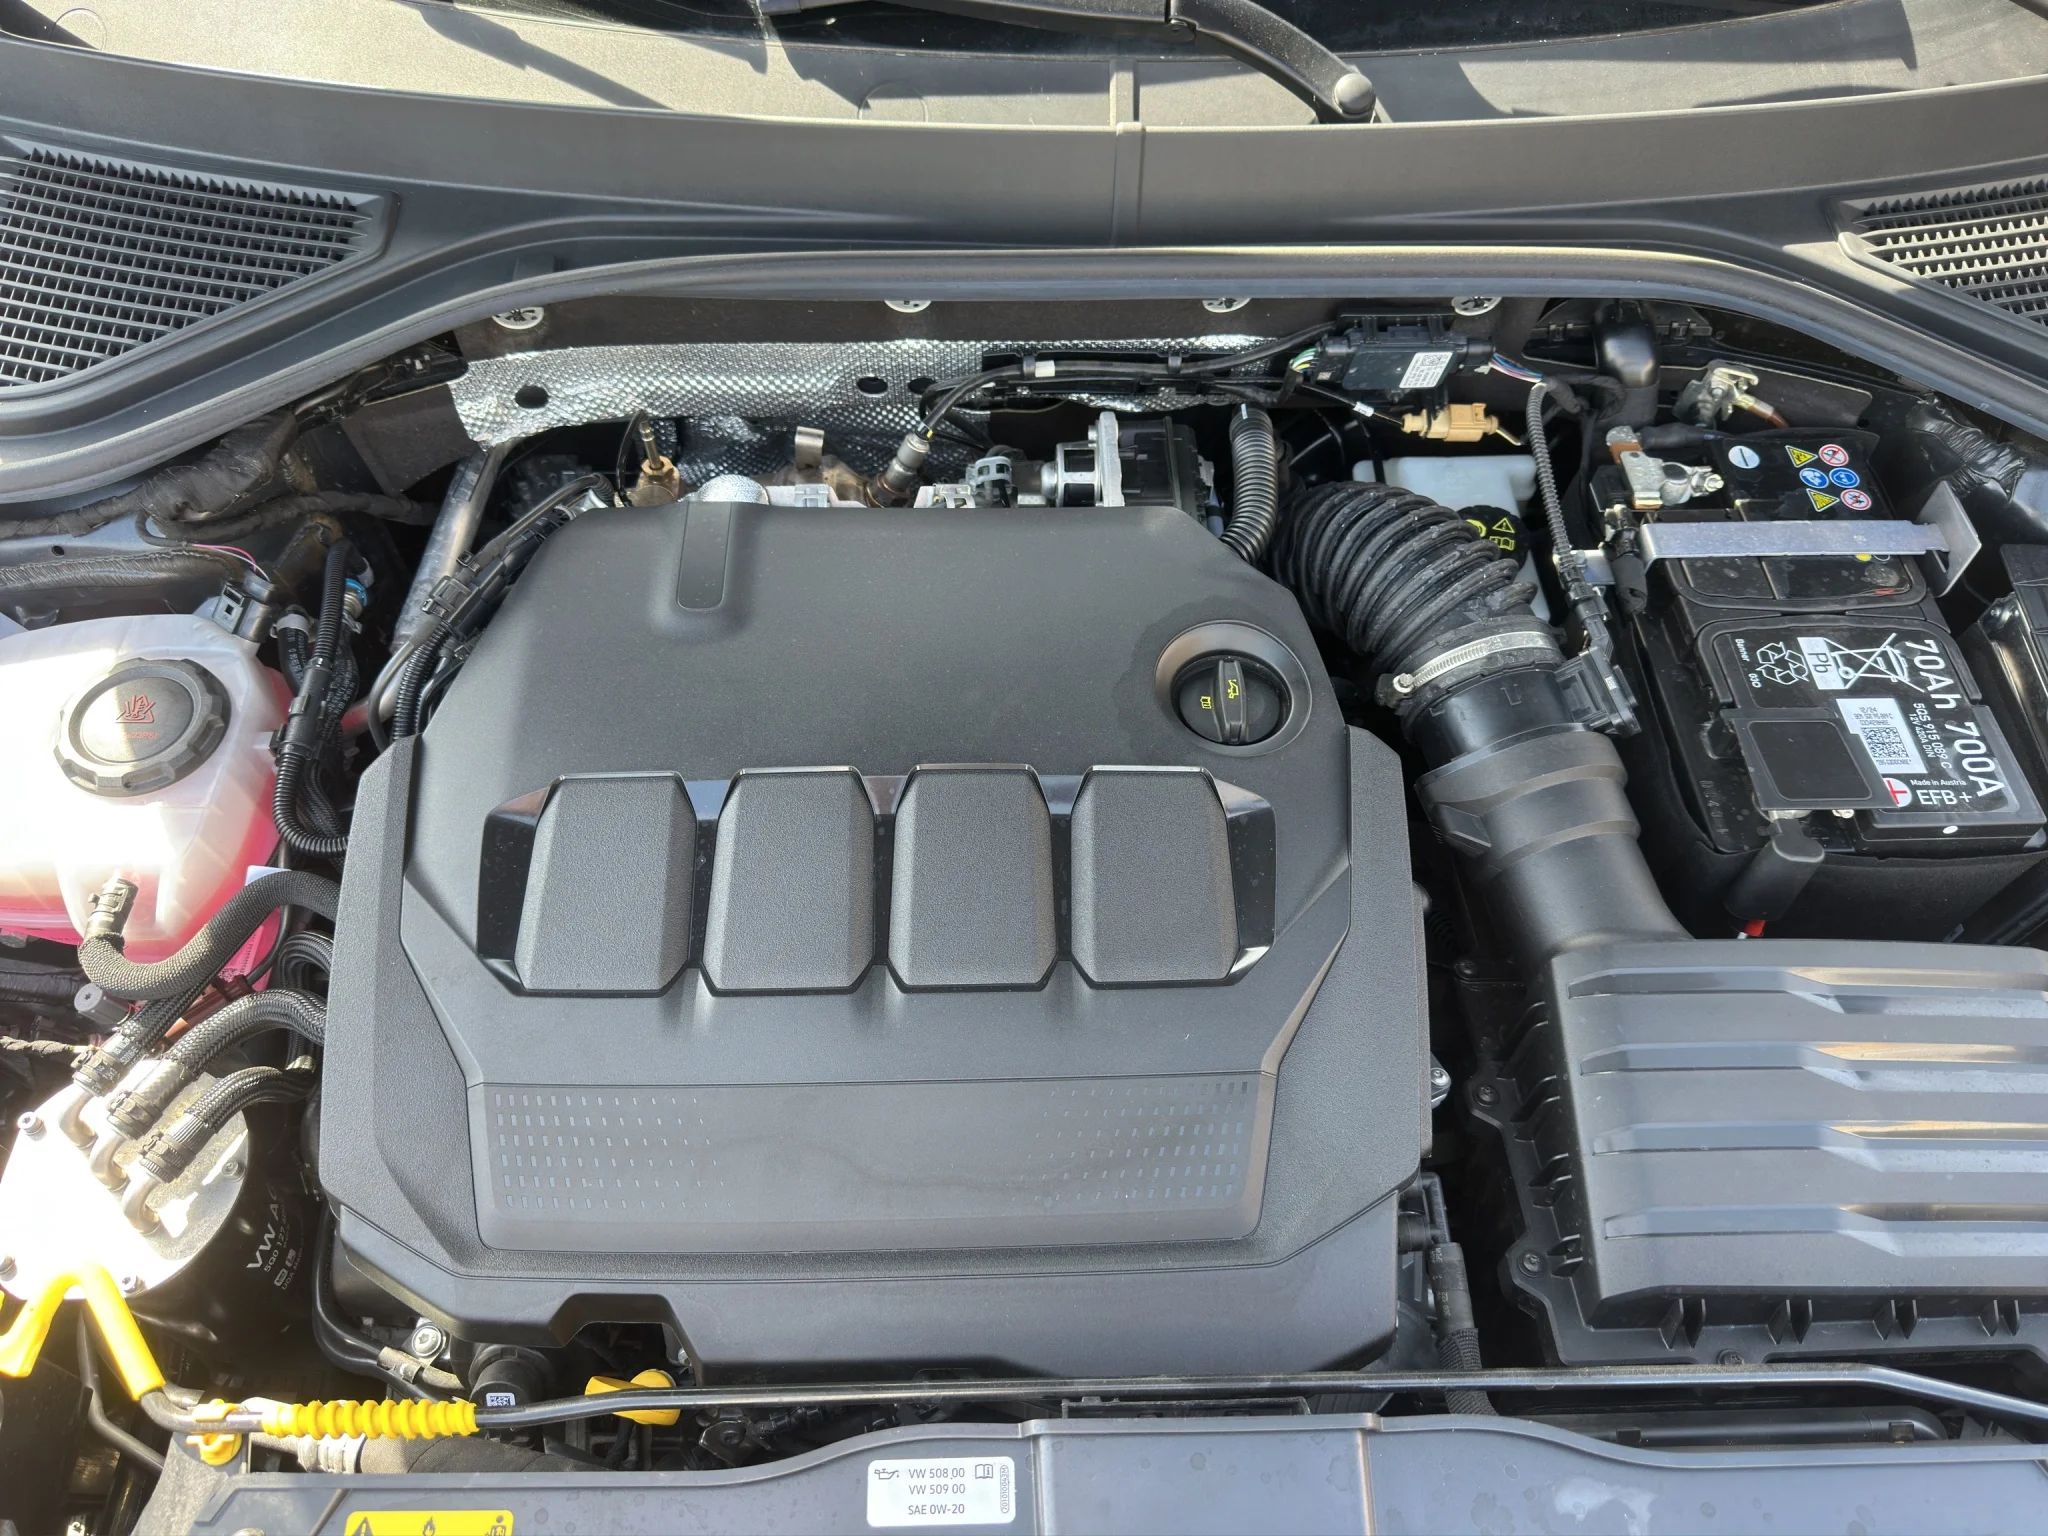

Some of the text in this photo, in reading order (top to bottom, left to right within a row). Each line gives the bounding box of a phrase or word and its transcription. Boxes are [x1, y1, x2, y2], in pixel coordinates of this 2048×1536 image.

[1808, 652, 1832, 673] Pb
[1905, 639, 2005, 797] 70Ah 700A
[1908, 713, 1936, 758] 12V 420A DIN
[1913, 703, 1952, 769] 5QS 915 089 C
[1916, 789, 1957, 805] EFB
[246, 1222, 275, 1268] VW
[908, 1467, 965, 1479] VW 508 00
[908, 1483, 965, 1495] VW 509 00
[908, 1503, 965, 1515] SAE 0W-20
